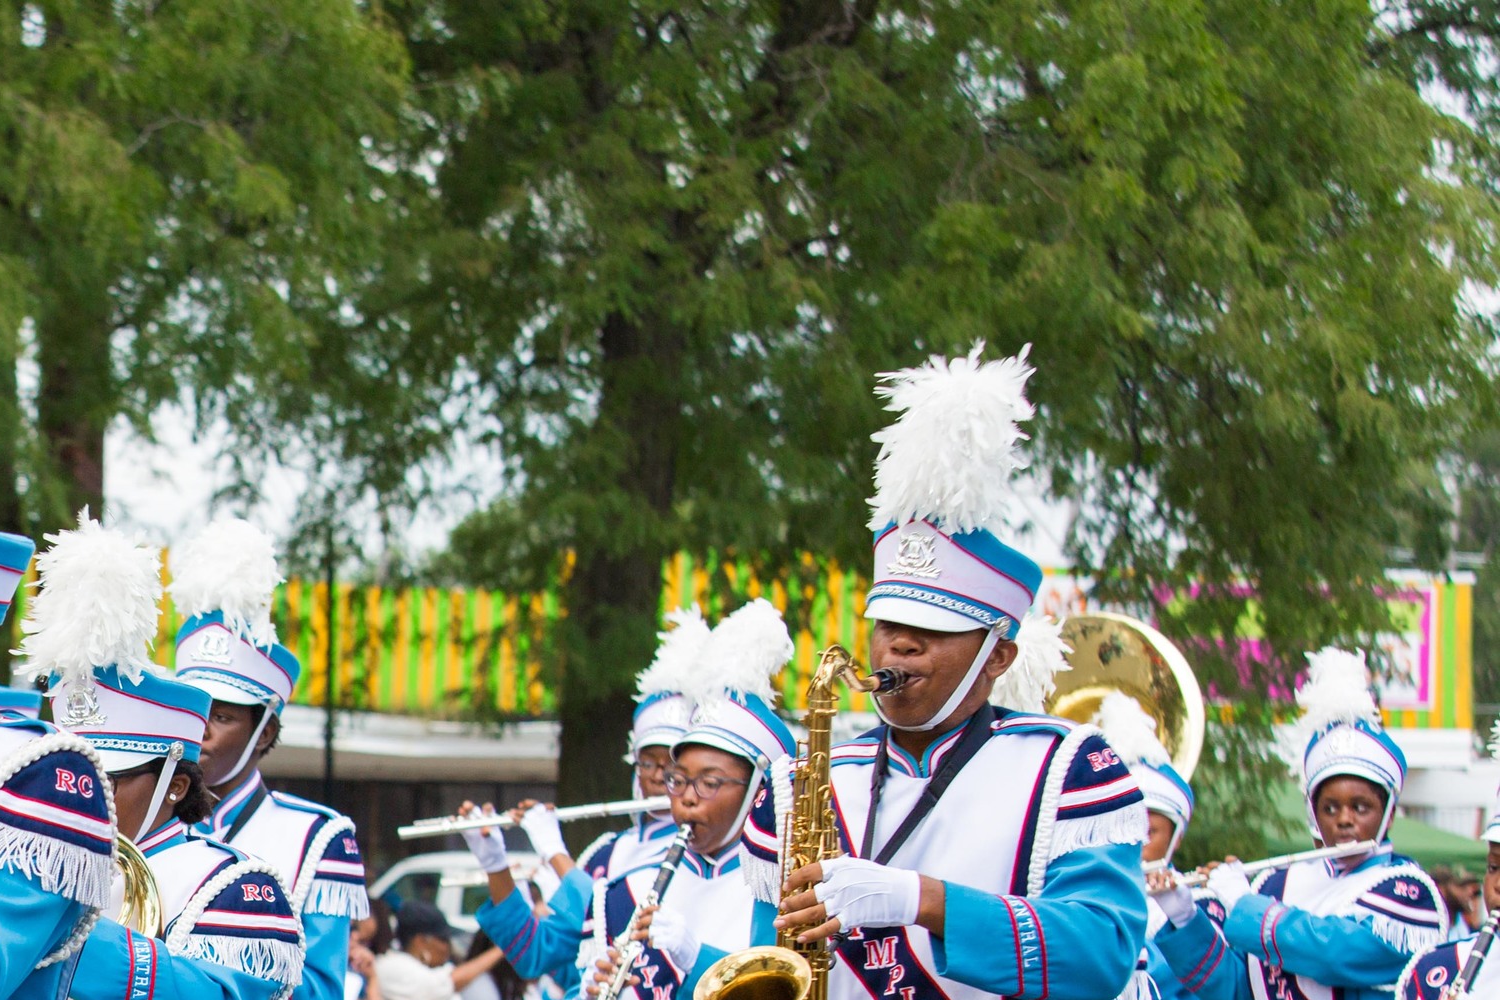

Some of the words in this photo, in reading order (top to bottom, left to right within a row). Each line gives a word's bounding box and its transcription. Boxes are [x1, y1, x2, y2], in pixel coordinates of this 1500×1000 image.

[1086, 748, 1120, 772] RC
[55, 768, 94, 798] RC
[241, 883, 276, 903] RC
[1394, 880, 1420, 900] RC
